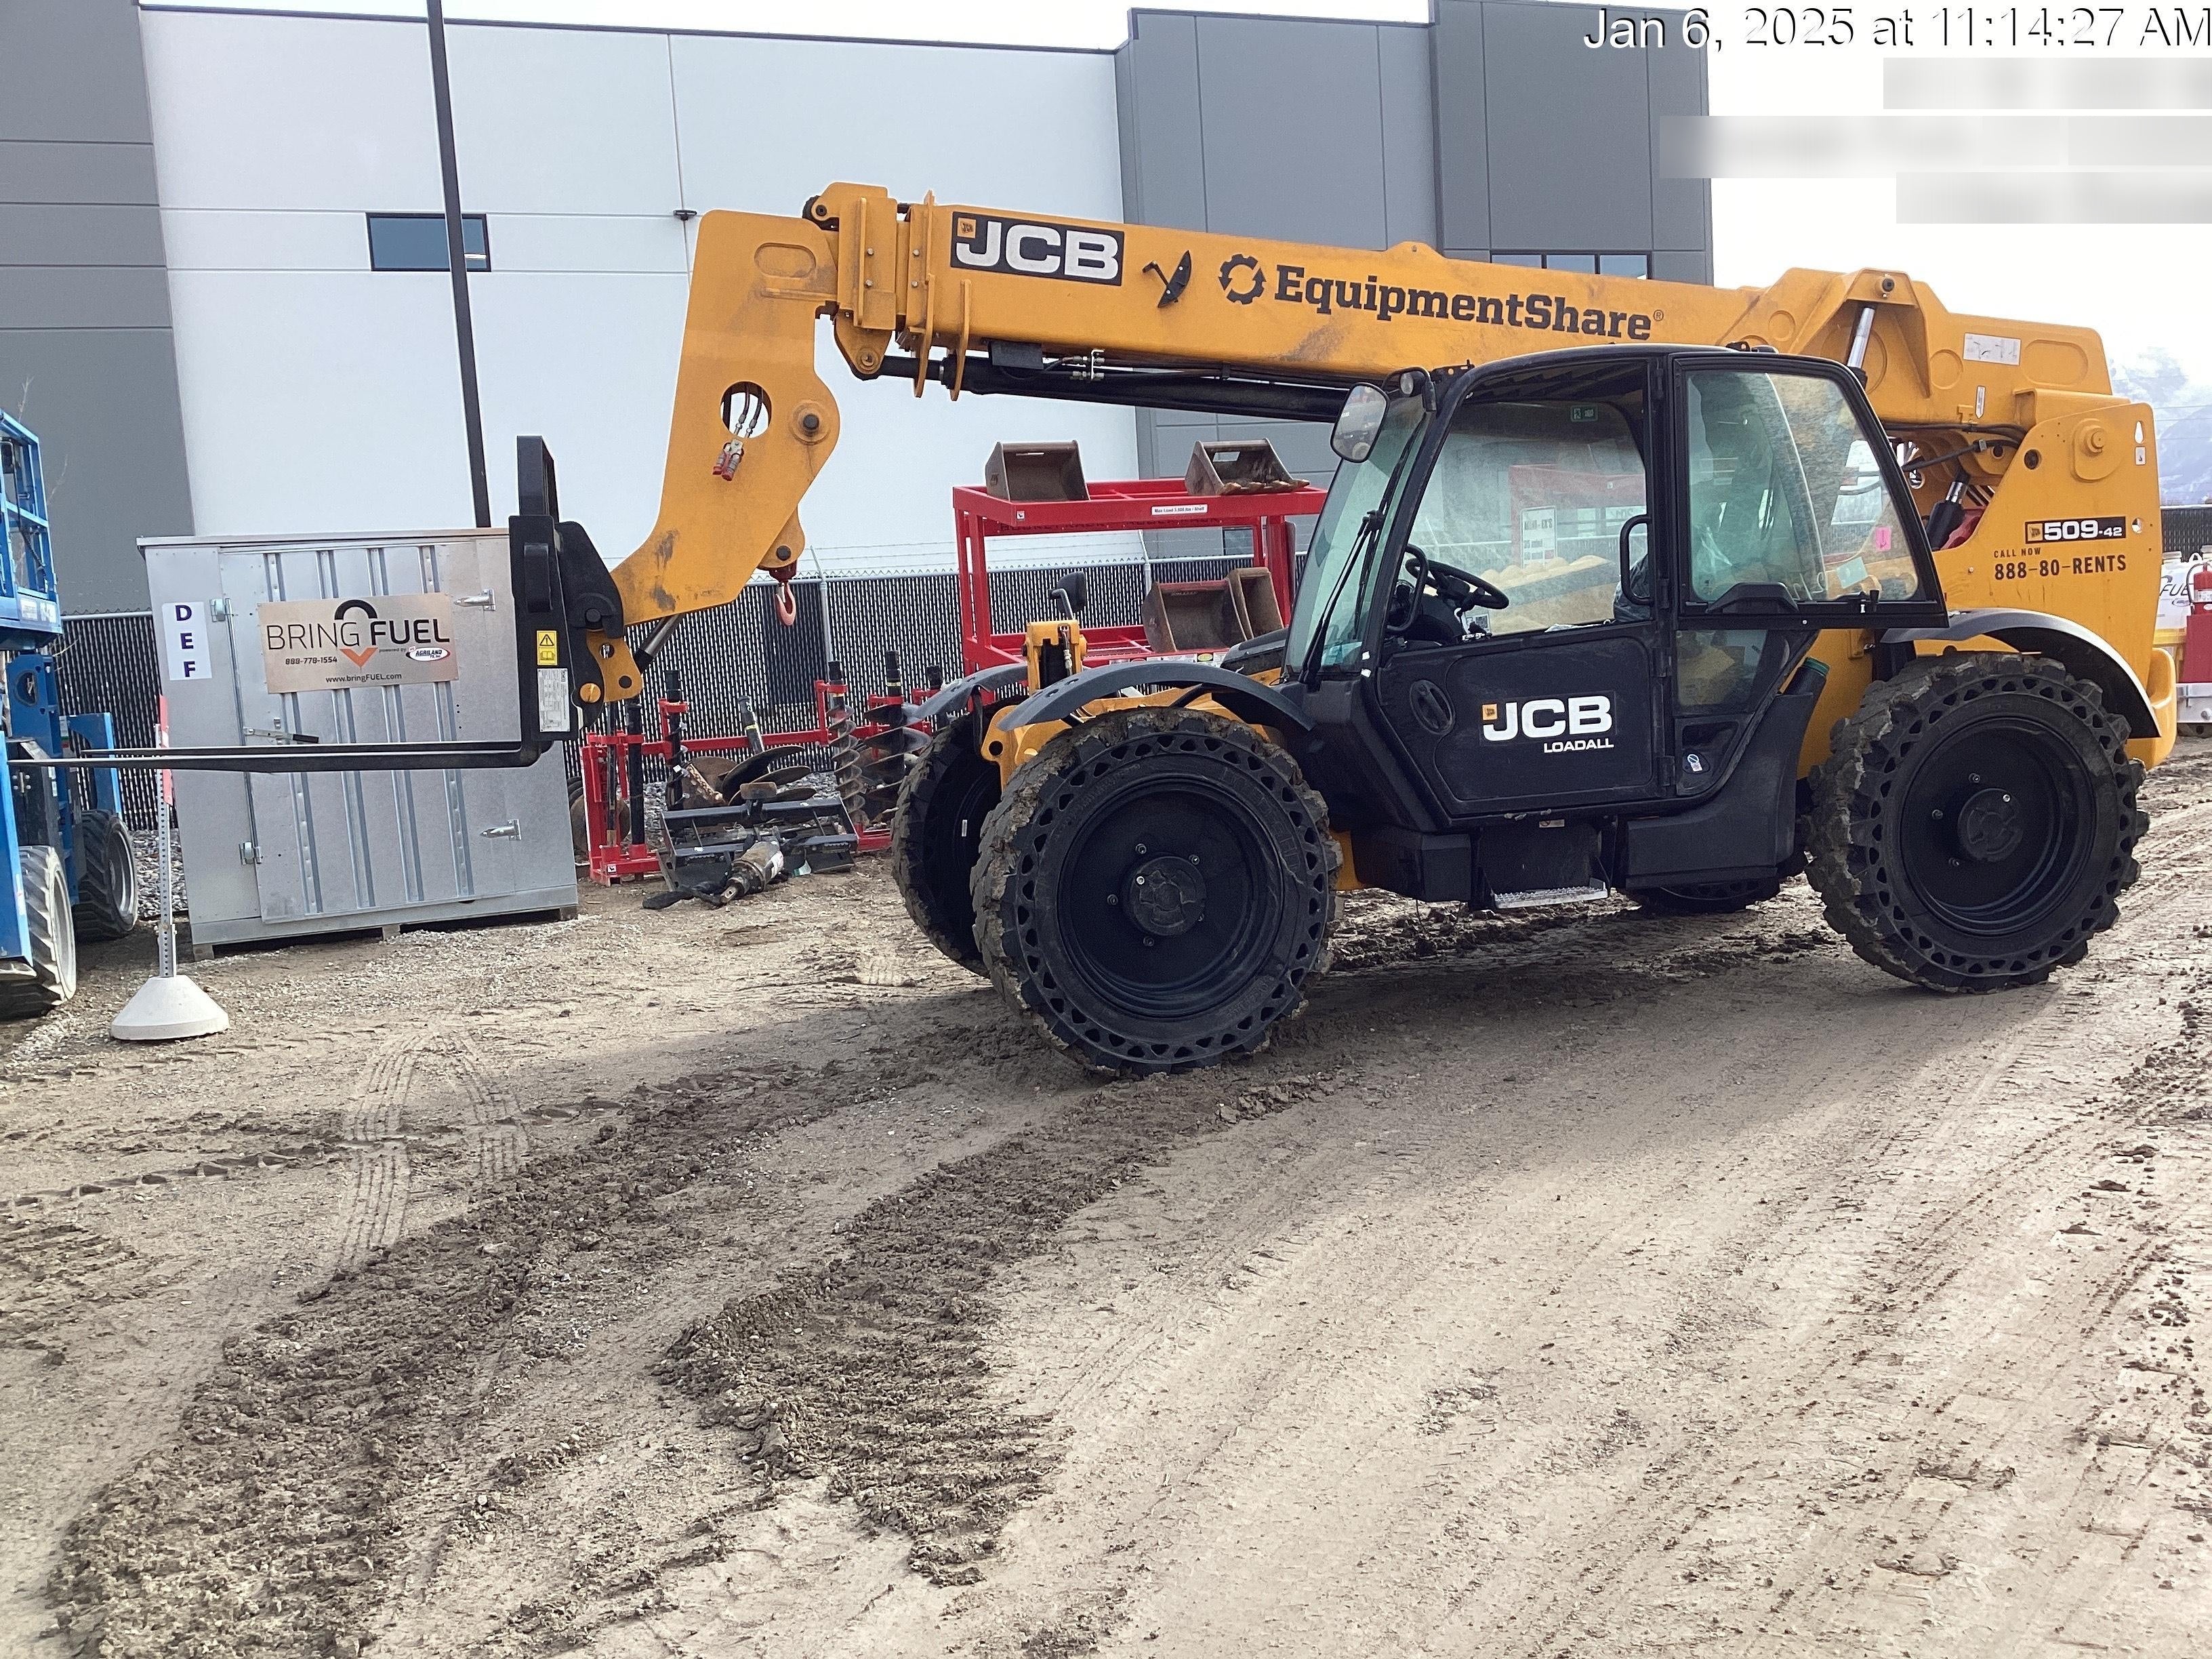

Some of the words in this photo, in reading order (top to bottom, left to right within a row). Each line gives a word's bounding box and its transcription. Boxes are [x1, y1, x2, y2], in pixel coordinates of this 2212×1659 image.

[956, 220, 1119, 280] JCB
[2044, 520, 2123, 540] 509-42
[1994, 549, 2017, 558] CALL
[2021, 548, 2041, 556] NOW
[1994, 554, 2127, 581] 888-80-RENTS
[266, 622, 360, 650] BRING
[369, 619, 450, 646] FUEL
[285, 656, 337, 665] 888-778-1554
[325, 673, 403, 683] www.bringFUEL.com
[1483, 695, 1613, 741] JCB
[1544, 738, 1615, 754] LOADALL
